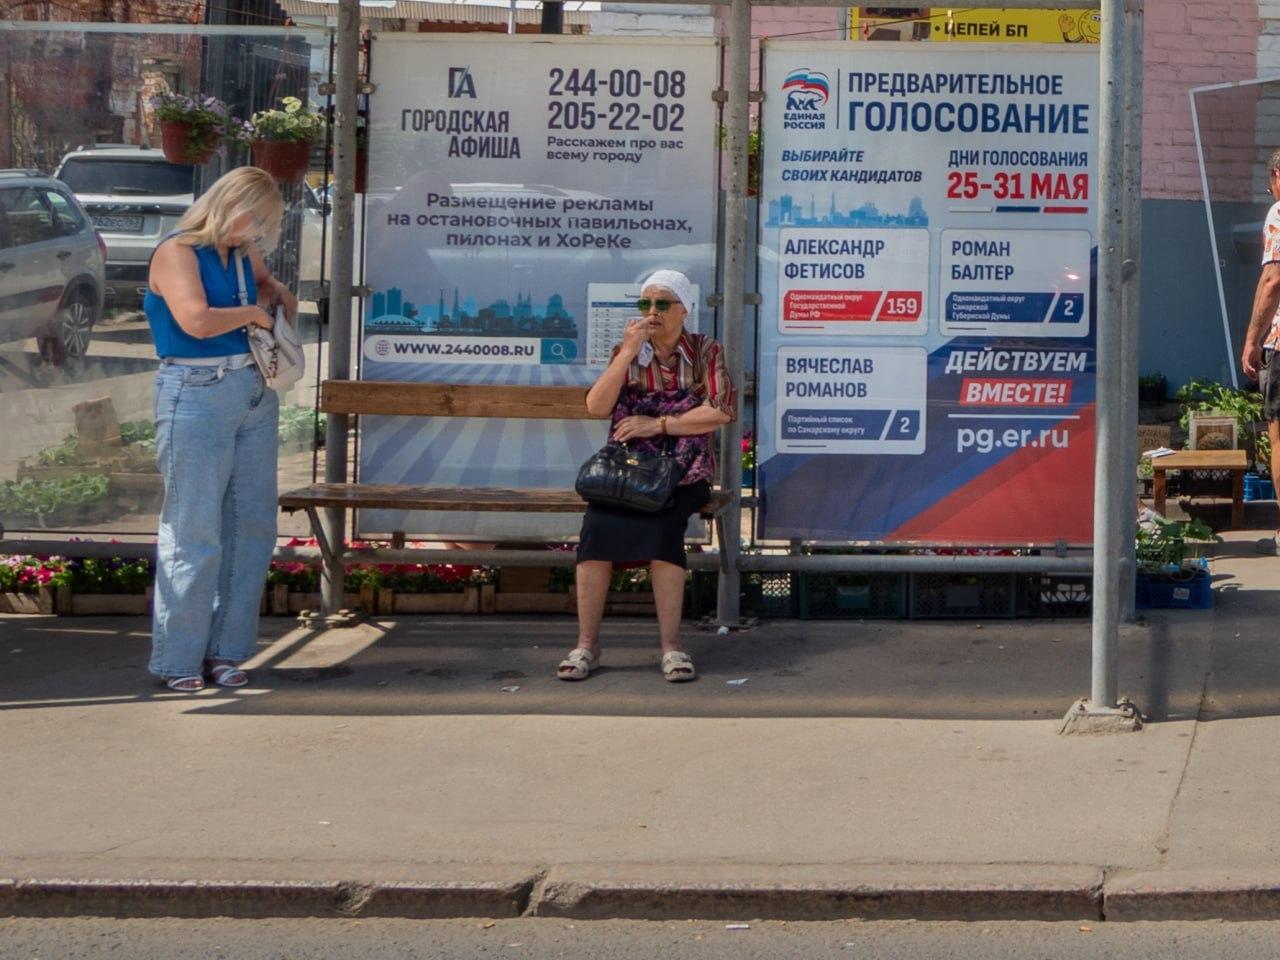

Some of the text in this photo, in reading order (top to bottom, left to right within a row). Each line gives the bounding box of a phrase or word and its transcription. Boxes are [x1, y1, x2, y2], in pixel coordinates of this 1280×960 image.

[944, 21, 1028, 37] ЦЕПЕЙ БП
[549, 68, 686, 98] 244-00-08
[848, 72, 1063, 96] ПРЕДВАРИТЕЛЬНОЕ
[401, 109, 510, 133] ГОРОДСКАЯ
[548, 101, 685, 131] 205-22-02
[784, 113, 825, 121] ЕДИНАЯ
[848, 101, 1089, 134] ГОЛОСОВАНИЕ
[784, 121, 825, 130] РОССИЯ
[448, 135, 521, 159] АФИША
[547, 136, 684, 151] Расскажем про вас
[547, 150, 643, 163] всему городу
[781, 149, 864, 163] ВЫБИРАЙТЕ
[948, 150, 1088, 168] ДНИ ГОЛОСОВАНИЯ
[781, 170, 922, 184] СВОИХ КАНДИДАТОВ
[947, 171, 1089, 200] 25-31 МАЯ
[426, 193, 654, 214] Размещение рекламы
[387, 213, 693, 234] на остановочных павильонах,
[446, 234, 632, 249] пилонах и ХоРеКе
[784, 239, 885, 258] АЛЕКСАНДР
[951, 240, 1010, 257] РОМАН
[784, 263, 865, 279] ФЕТИСОВ
[951, 264, 1014, 281] БАЛТЕР
[887, 298, 917, 314] 159
[1064, 300, 1074, 316] 2
[393, 342, 535, 357] WWW.2440008.RU
[786, 358, 874, 374] ВЯЧЕСЛАВ
[944, 347, 1087, 374] ДЕЙСТВУЕМ
[786, 382, 867, 398] РОМАНОВ
[966, 383, 1066, 403] ВМЕСТЕ!
[900, 417, 910, 432] 2
[956, 426, 1069, 453] pg.er.ru
